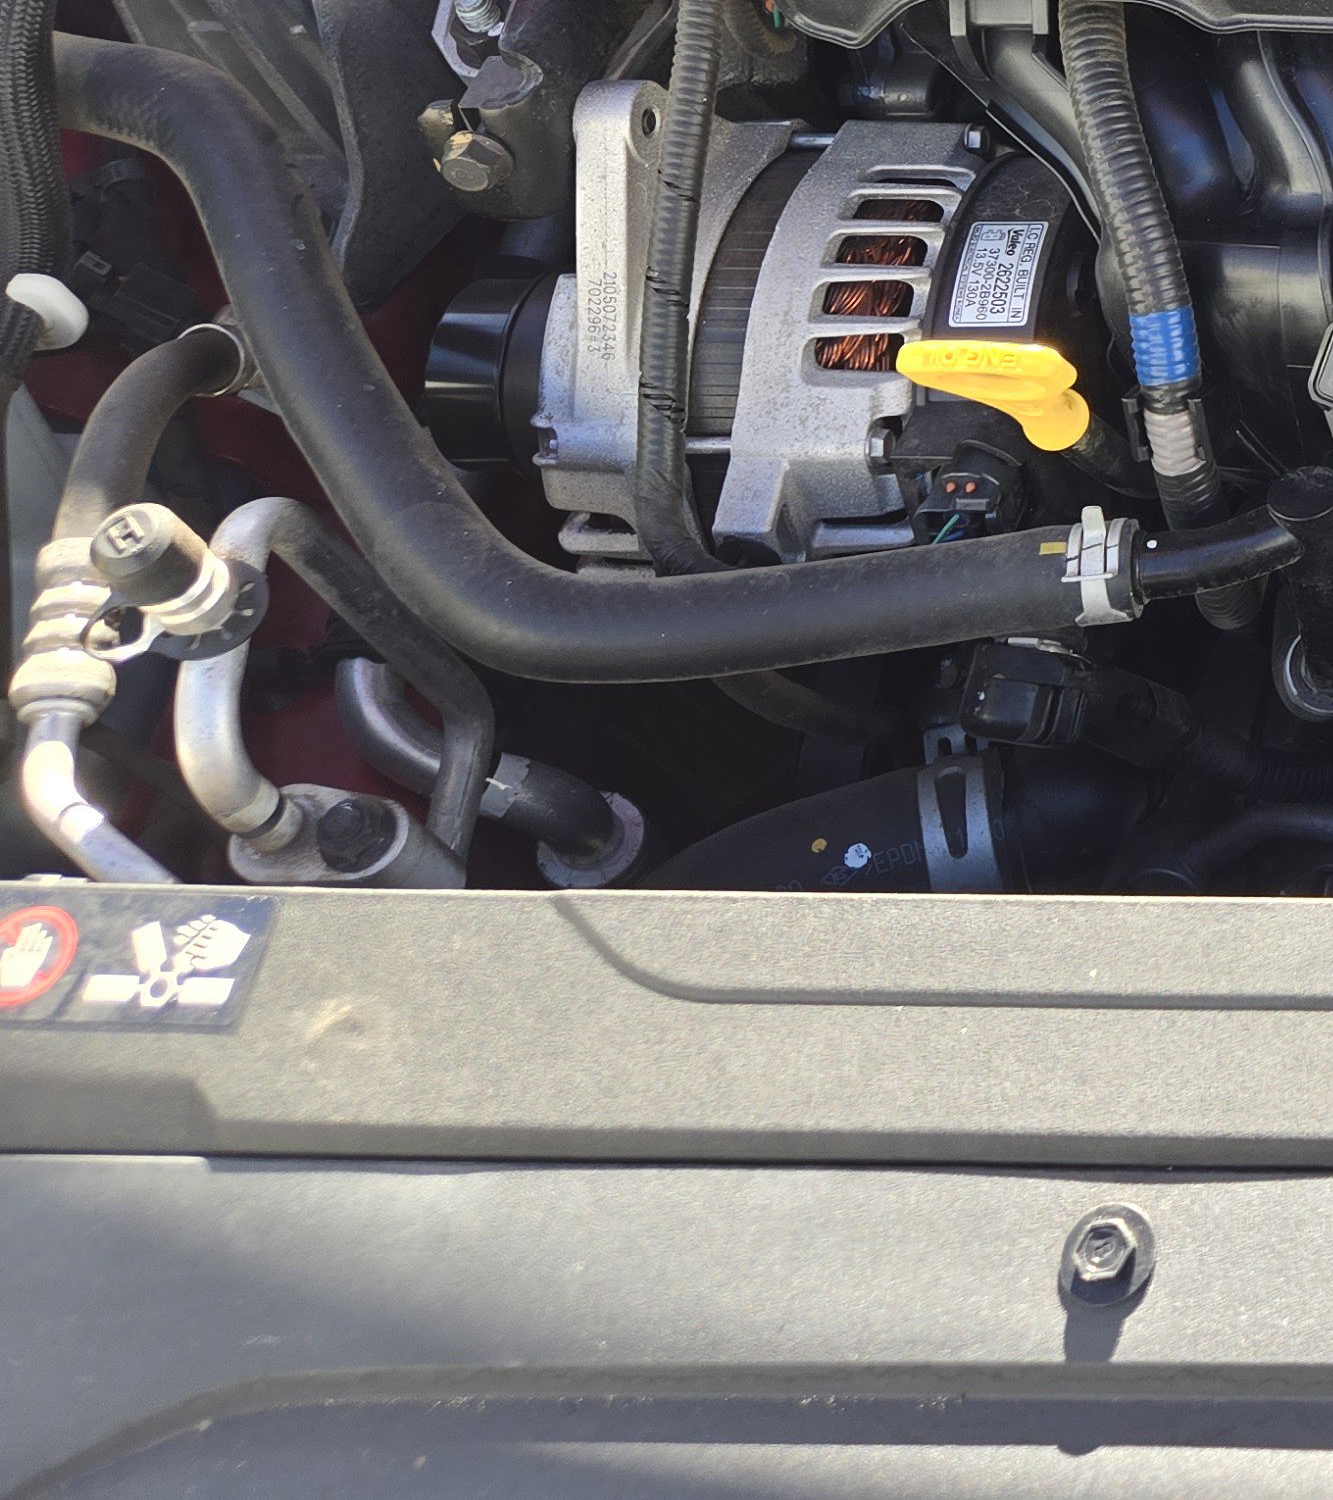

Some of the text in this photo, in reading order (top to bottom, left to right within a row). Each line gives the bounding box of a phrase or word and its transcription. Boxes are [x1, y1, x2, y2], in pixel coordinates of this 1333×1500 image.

[971, 248, 988, 276] 13.5V
[1019, 242, 1036, 266] REG.
[976, 247, 1000, 321] 37300-2B960
[989, 227, 1025, 314] Valeo 2622503
[1013, 269, 1029, 300] BUILT
[965, 280, 980, 307] 130A
[587, 278, 603, 353] 702296#3
[602, 271, 617, 361] 2105072346
[1010, 307, 1022, 319] IN
